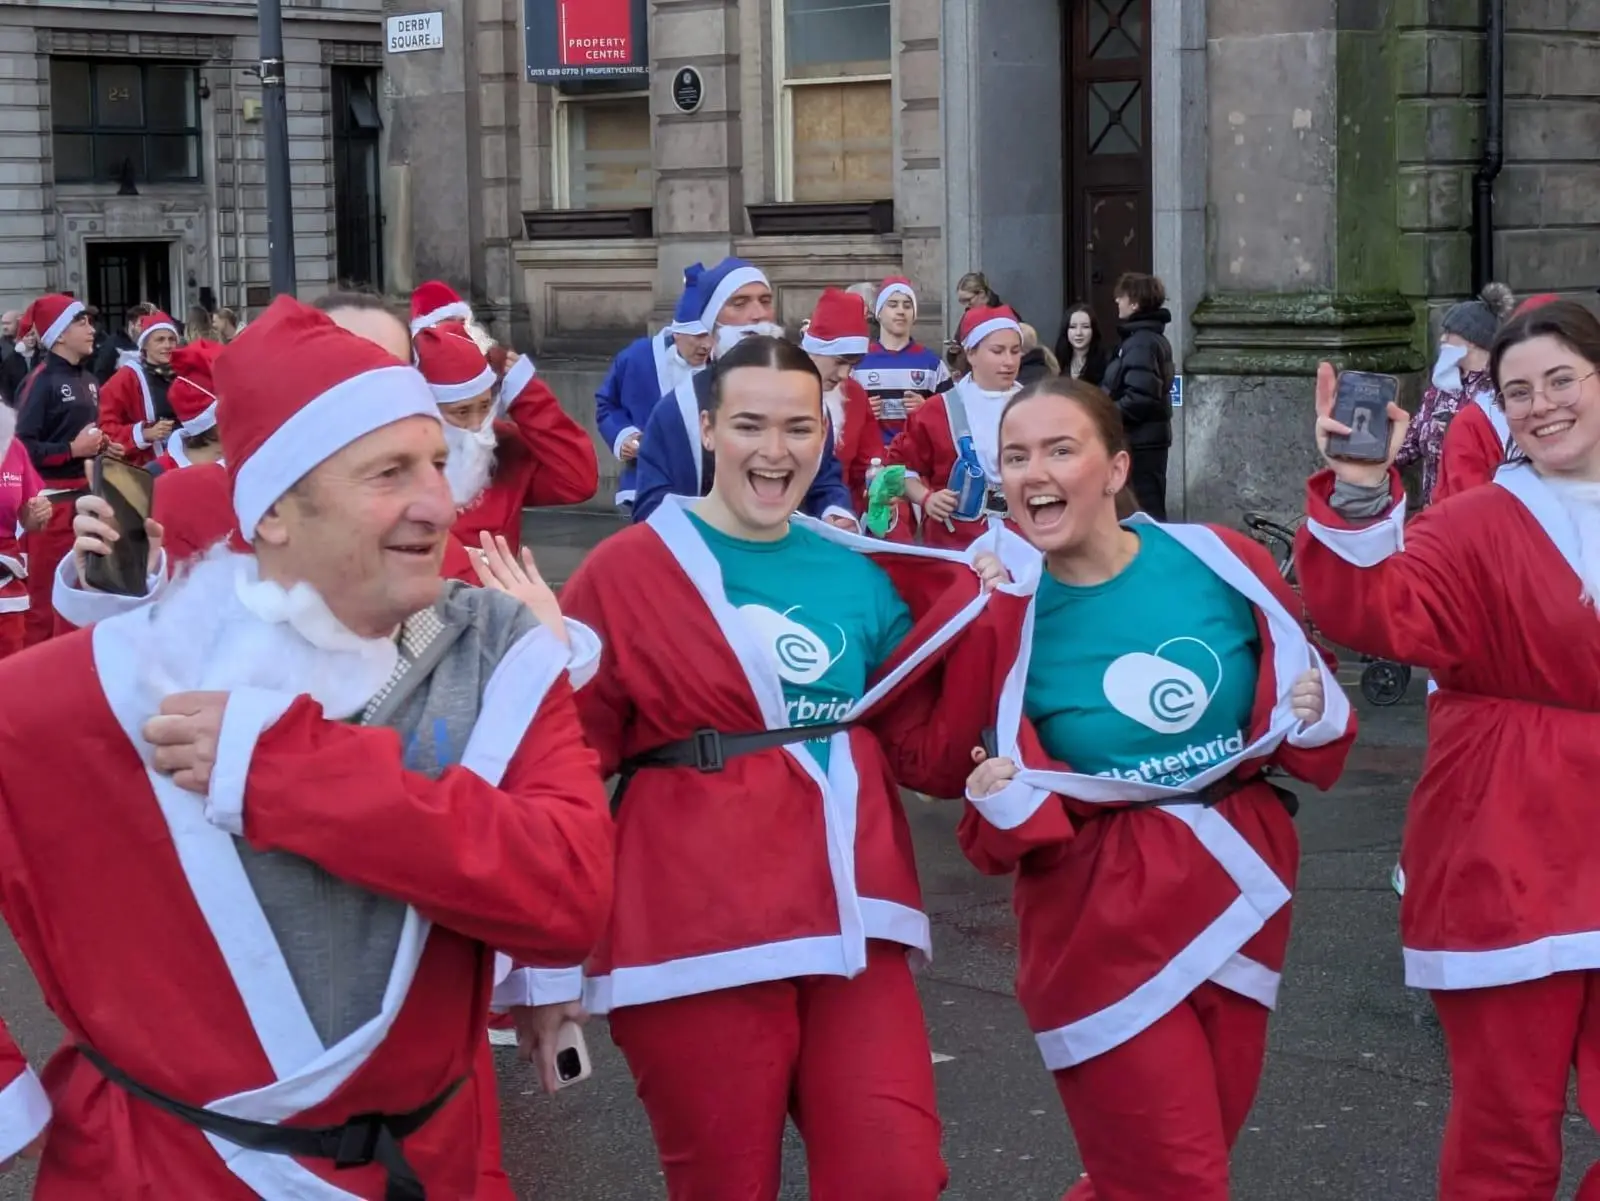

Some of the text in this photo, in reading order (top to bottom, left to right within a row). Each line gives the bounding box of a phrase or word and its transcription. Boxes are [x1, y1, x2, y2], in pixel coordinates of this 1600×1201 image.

[398, 17, 430, 33] DERBY
[391, 34, 430, 49] SQUARE
[569, 38, 626, 48] PROPERTY
[585, 50, 626, 59] CENTRE
[109, 87, 129, 101] 24
